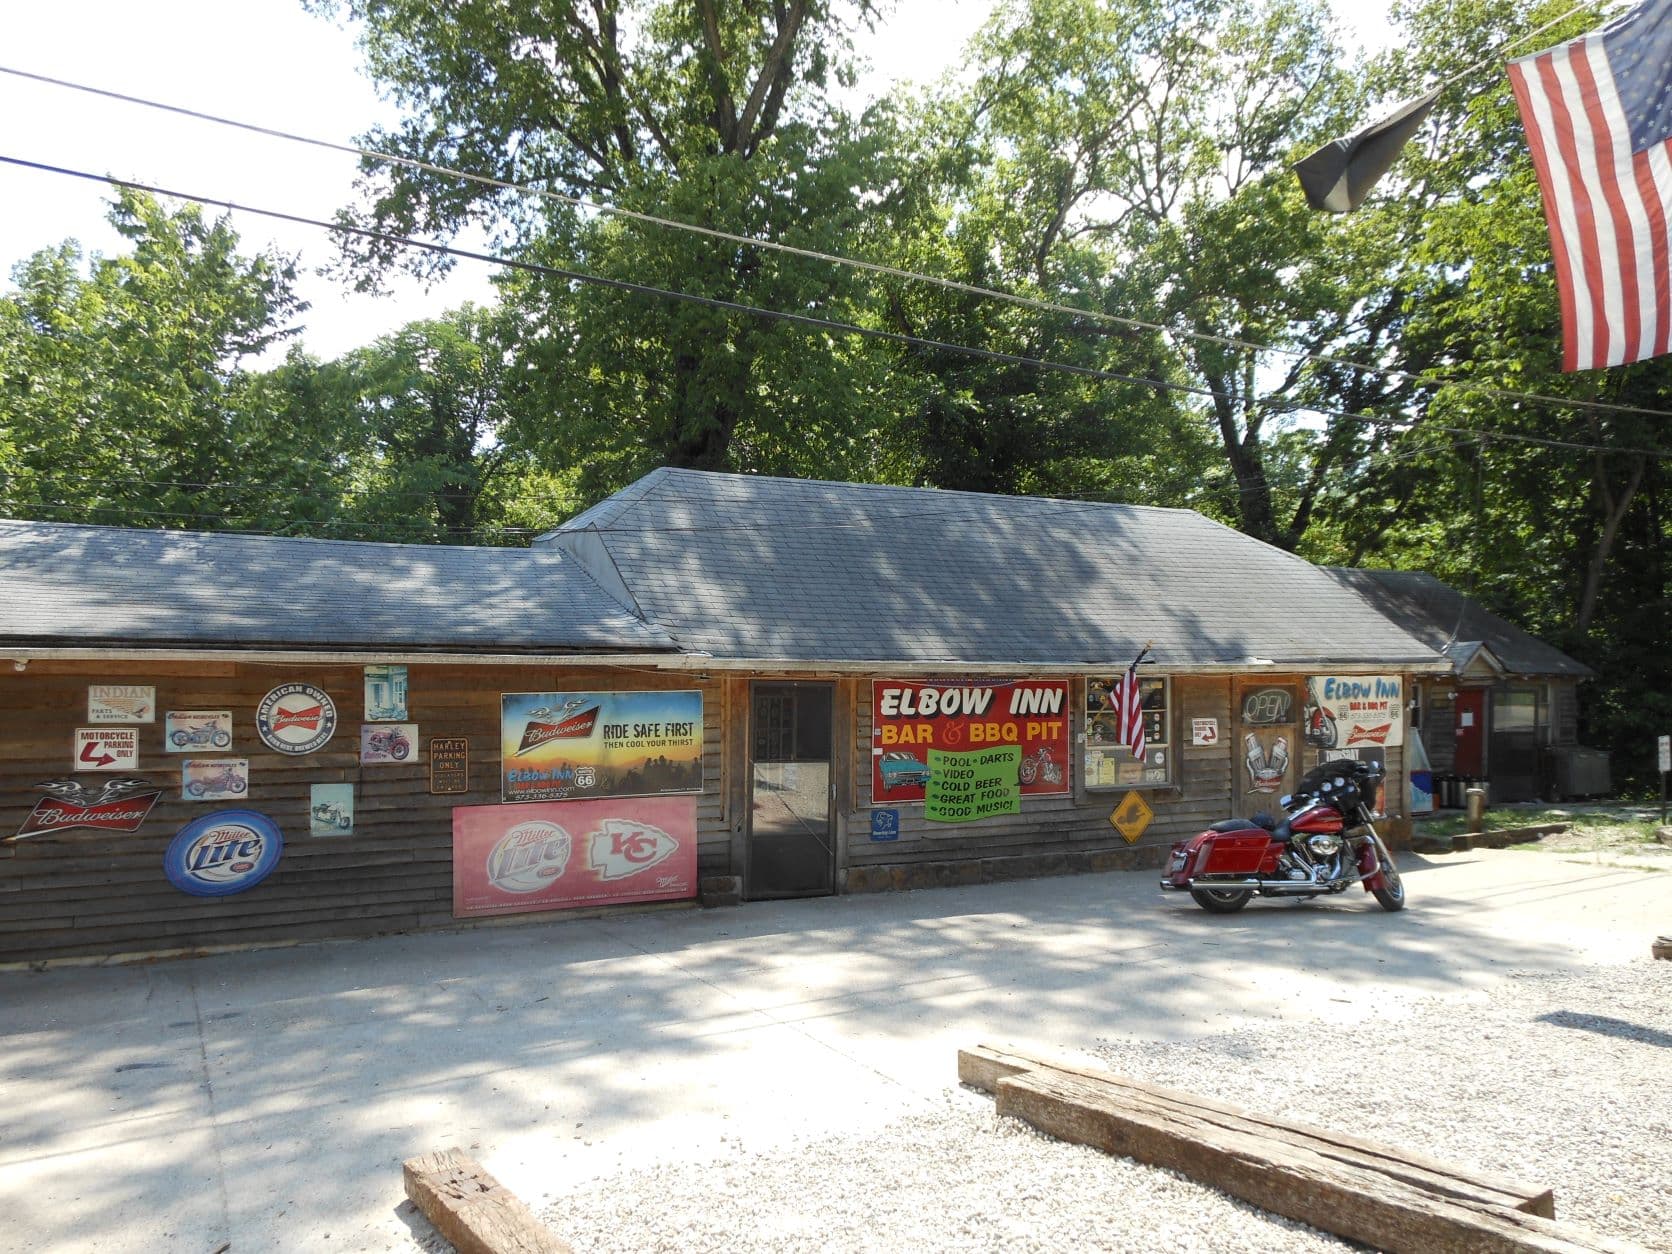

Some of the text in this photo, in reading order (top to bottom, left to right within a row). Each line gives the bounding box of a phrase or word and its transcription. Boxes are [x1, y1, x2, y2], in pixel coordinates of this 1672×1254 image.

[92, 687, 152, 699] INDIAN
[1375, 677, 1400, 699] INN
[260, 686, 333, 721] AMERICAN OWNED
[880, 688, 1063, 716] ELBOW INN
[1246, 695, 1289, 717] OPEN
[80, 732, 134, 740] MOTORCYCLE
[526, 720, 594, 743] Budweiser
[603, 722, 694, 740] RIDE SAFE FIRST
[881, 720, 1062, 745] BAR & BBQ PIT
[104, 741, 134, 749] PARKING
[433, 742, 465, 750] HARLEY
[116, 750, 134, 758] ONLY
[433, 752, 466, 760] PARKING
[943, 752, 1014, 767] POOL DARTS
[577, 775, 593, 785] 66
[943, 769, 975, 779] VIDEO
[941, 777, 1002, 791] COLD BEER
[940, 787, 1010, 805] GREAT FOOD
[33, 808, 145, 825] Budweiser
[939, 800, 1013, 817] GOOD MUSIC!
[208, 829, 251, 843] Miller
[511, 830, 556, 846] Miller
[610, 831, 658, 863] KC
[188, 838, 262, 873] Lite
